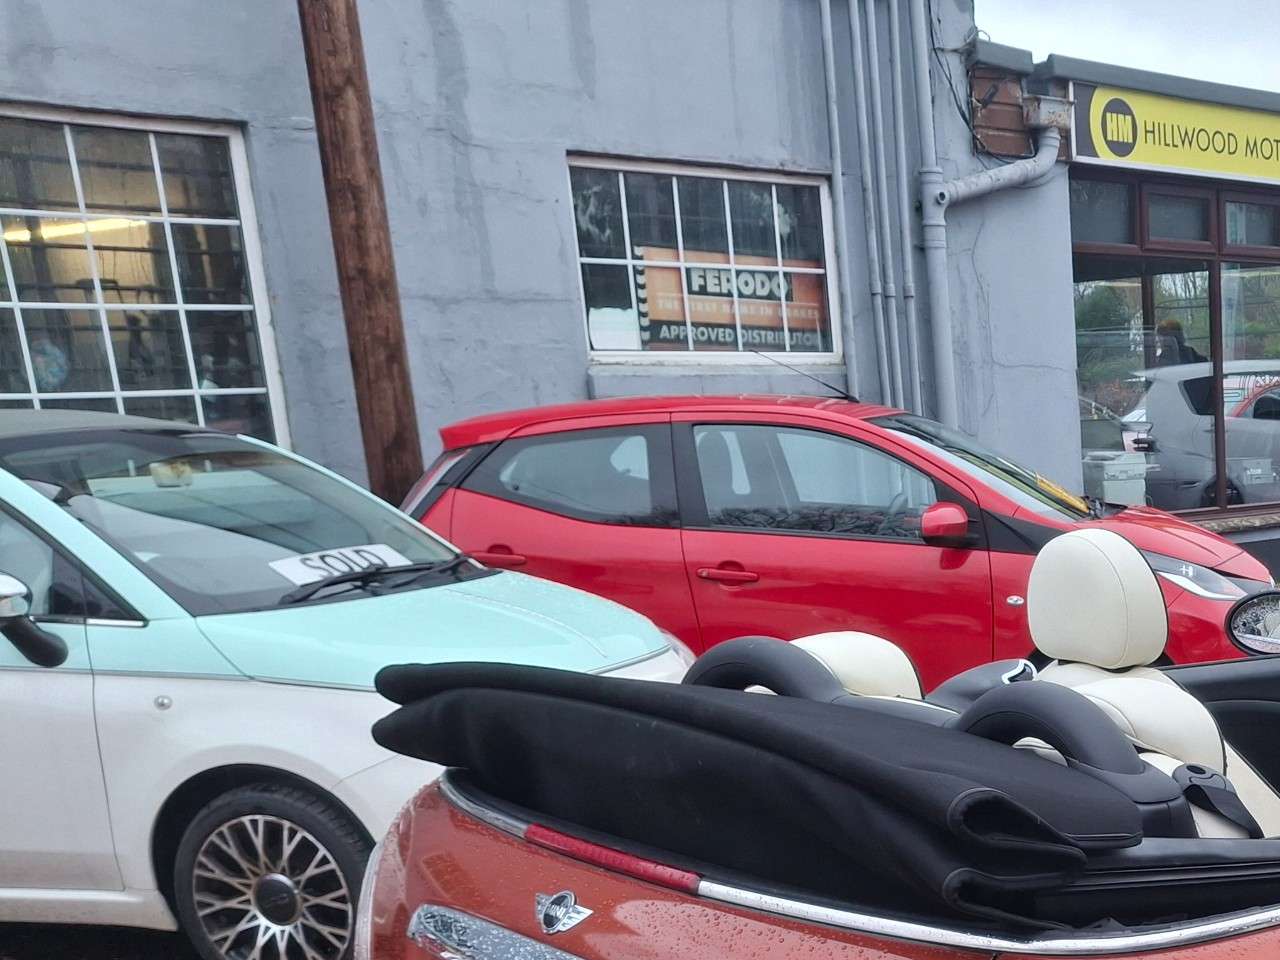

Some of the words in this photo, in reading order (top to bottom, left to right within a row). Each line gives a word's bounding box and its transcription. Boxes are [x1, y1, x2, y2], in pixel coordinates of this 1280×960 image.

[1105, 111, 1133, 143] HM
[1143, 119, 1238, 155] HILLWOOD
[690, 267, 789, 298] FERODO
[659, 324, 735, 342] APPROVED
[300, 549, 389, 577] SOLD
